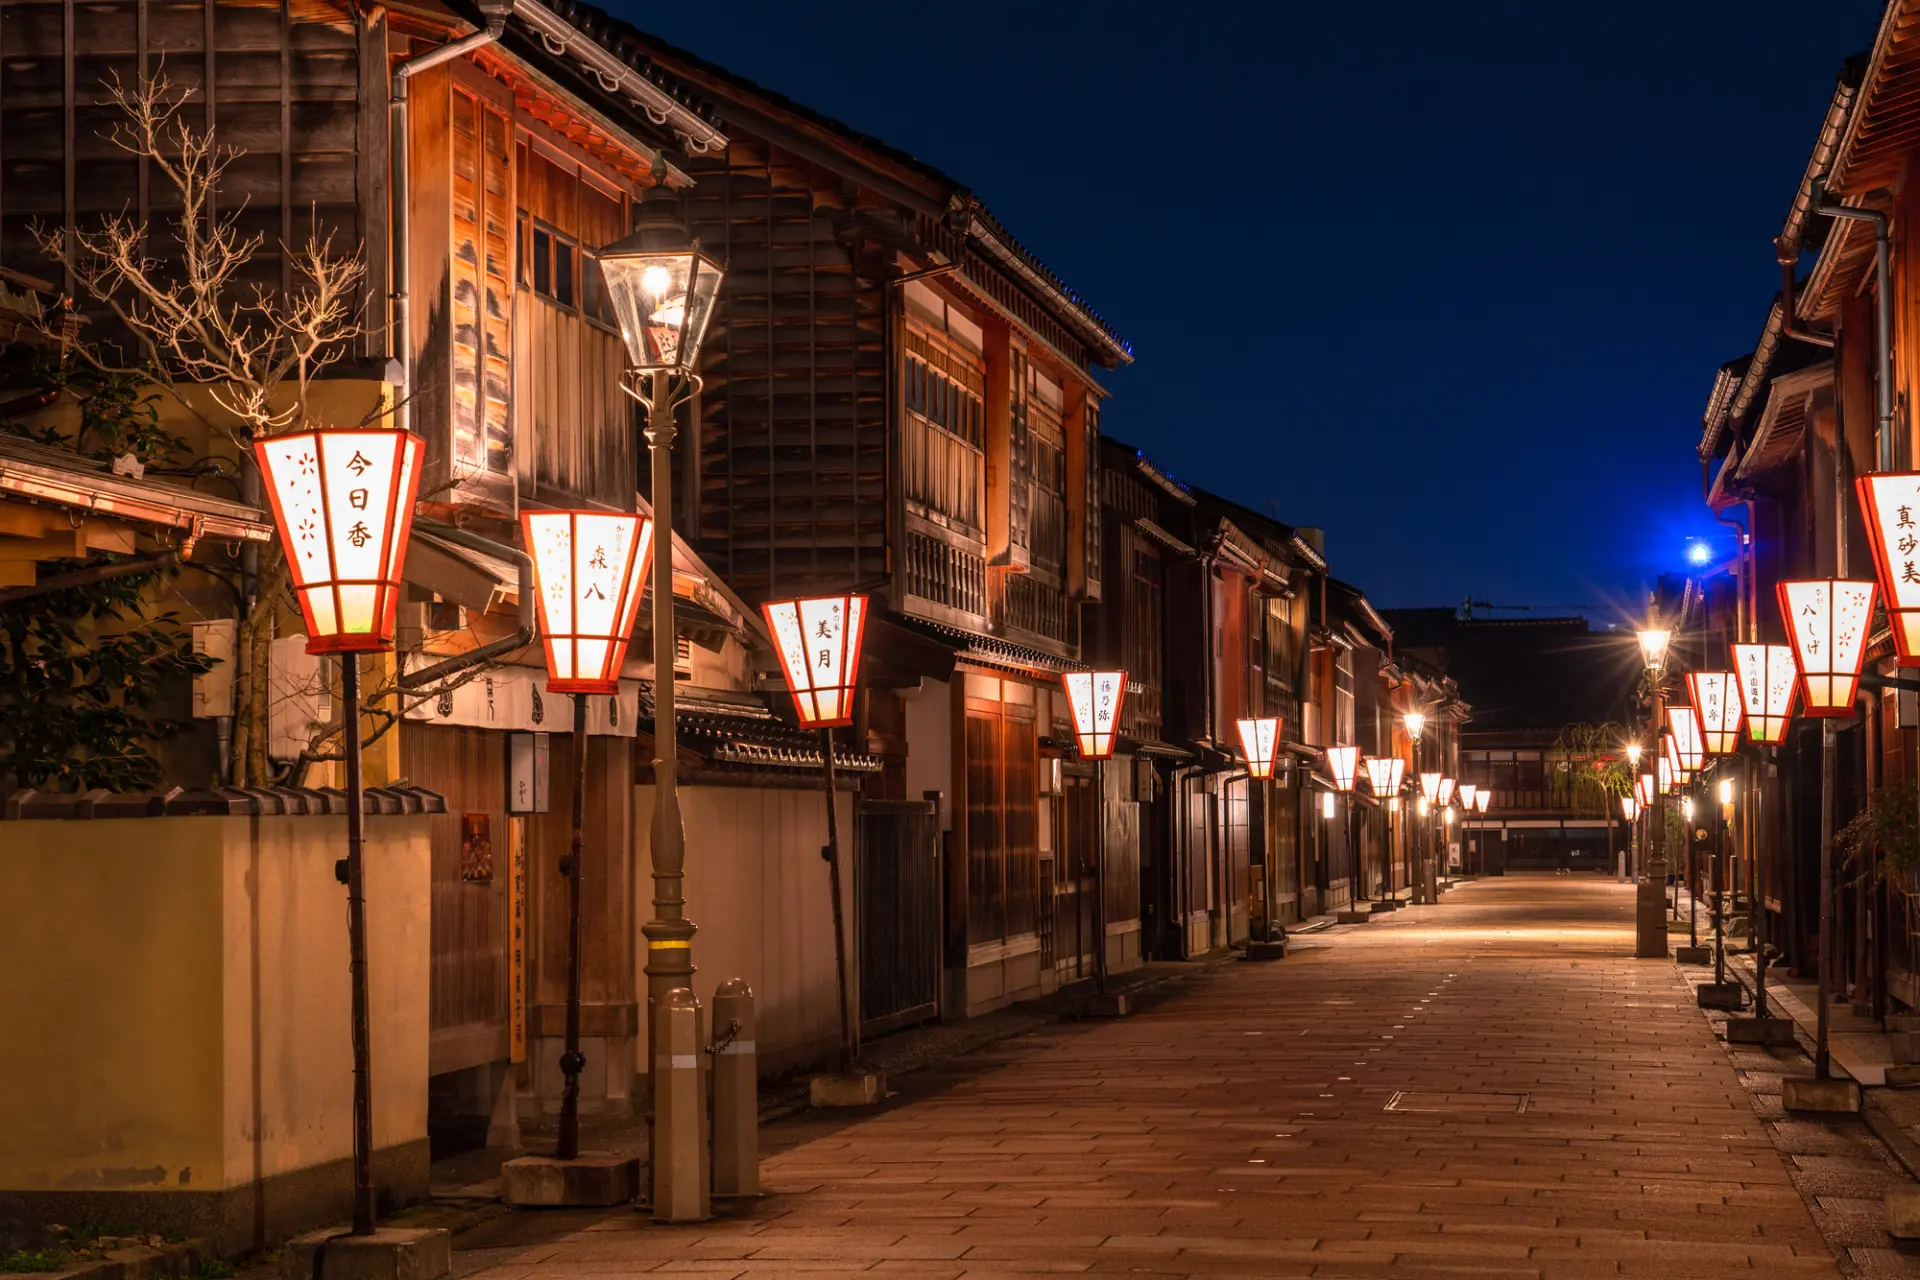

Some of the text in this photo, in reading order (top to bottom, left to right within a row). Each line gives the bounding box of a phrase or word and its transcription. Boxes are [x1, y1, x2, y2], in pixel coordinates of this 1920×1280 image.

[346, 450, 373, 548] 今日香
[1896, 505, 1920, 583] 真砂美
[584, 545, 608, 600] 森八
[816, 620, 832, 668] 美月
[1802, 604, 1820, 655] 八しげ
